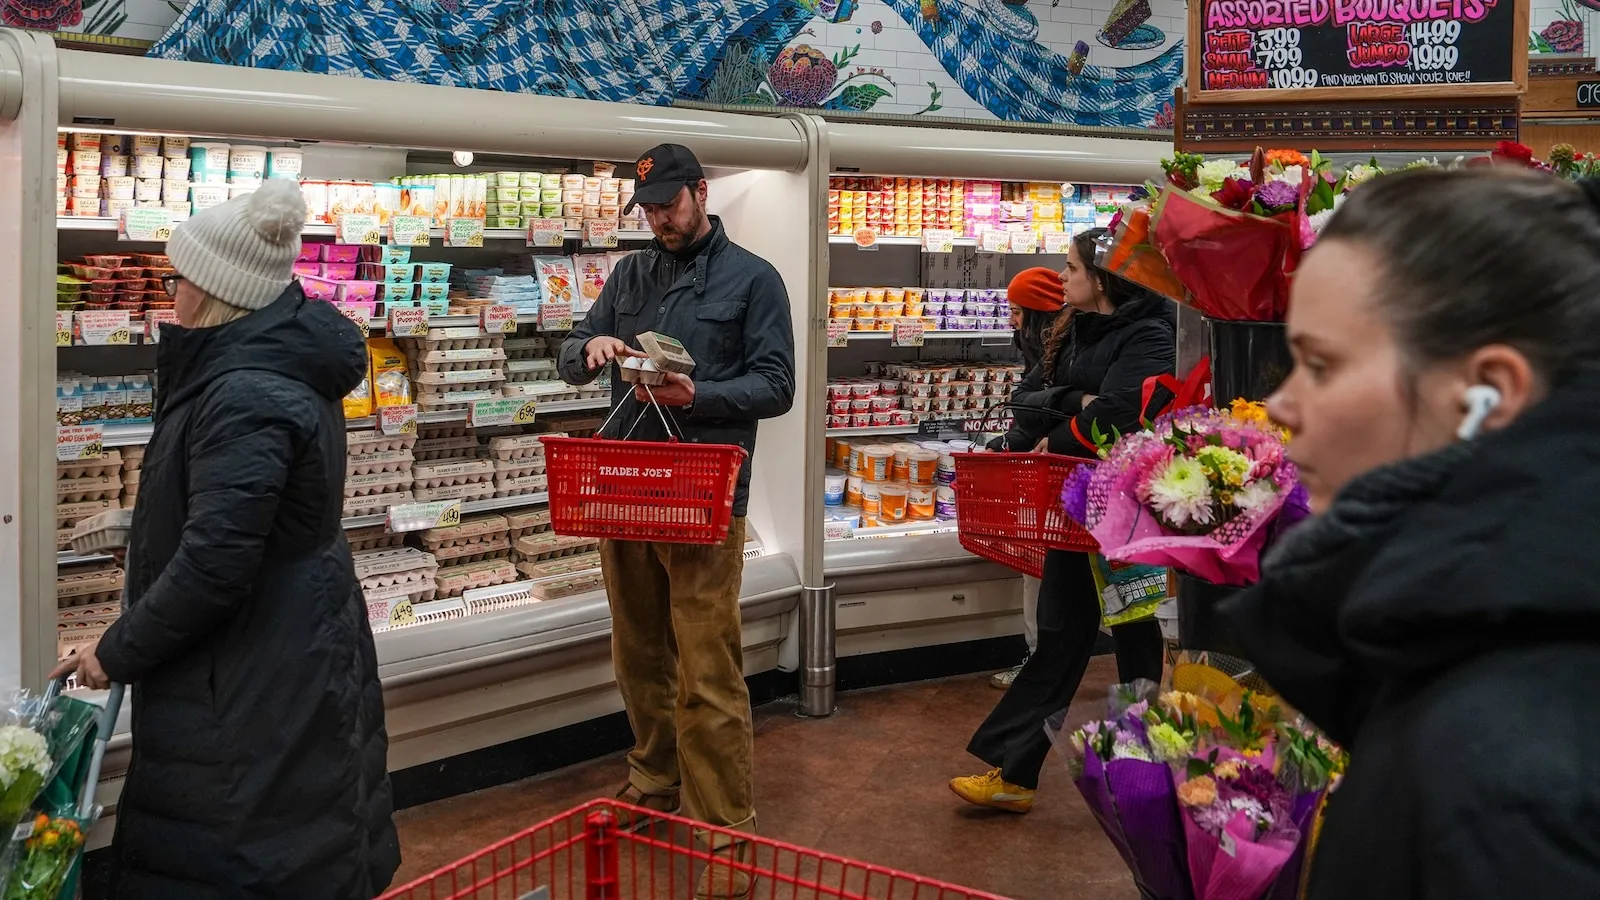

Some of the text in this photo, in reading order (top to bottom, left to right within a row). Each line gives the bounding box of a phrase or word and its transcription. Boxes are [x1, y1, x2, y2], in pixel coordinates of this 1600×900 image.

[1206, 0, 1486, 28] ASSORTED BOUQUETS
[1208, 33, 1253, 51] PETITE
[1350, 24, 1402, 46] LARGE
[1207, 53, 1253, 70] SMALL
[1351, 43, 1409, 64] JUMBO
[1208, 71, 1266, 89] MEDIUM
[1321, 70, 1470, 87] FIND YOUR WAY TO SHOW YOUR LOVE!!
[396, 224, 425, 233] BISCUITS
[451, 225, 481, 233] CRESCENT
[395, 309, 424, 318] CHOCOLATE
[519, 406, 536, 421] 6.99
[74, 434, 86, 442] EGG
[599, 466, 673, 478] TRADER JOE'S
[394, 604, 412, 621] 4.49
